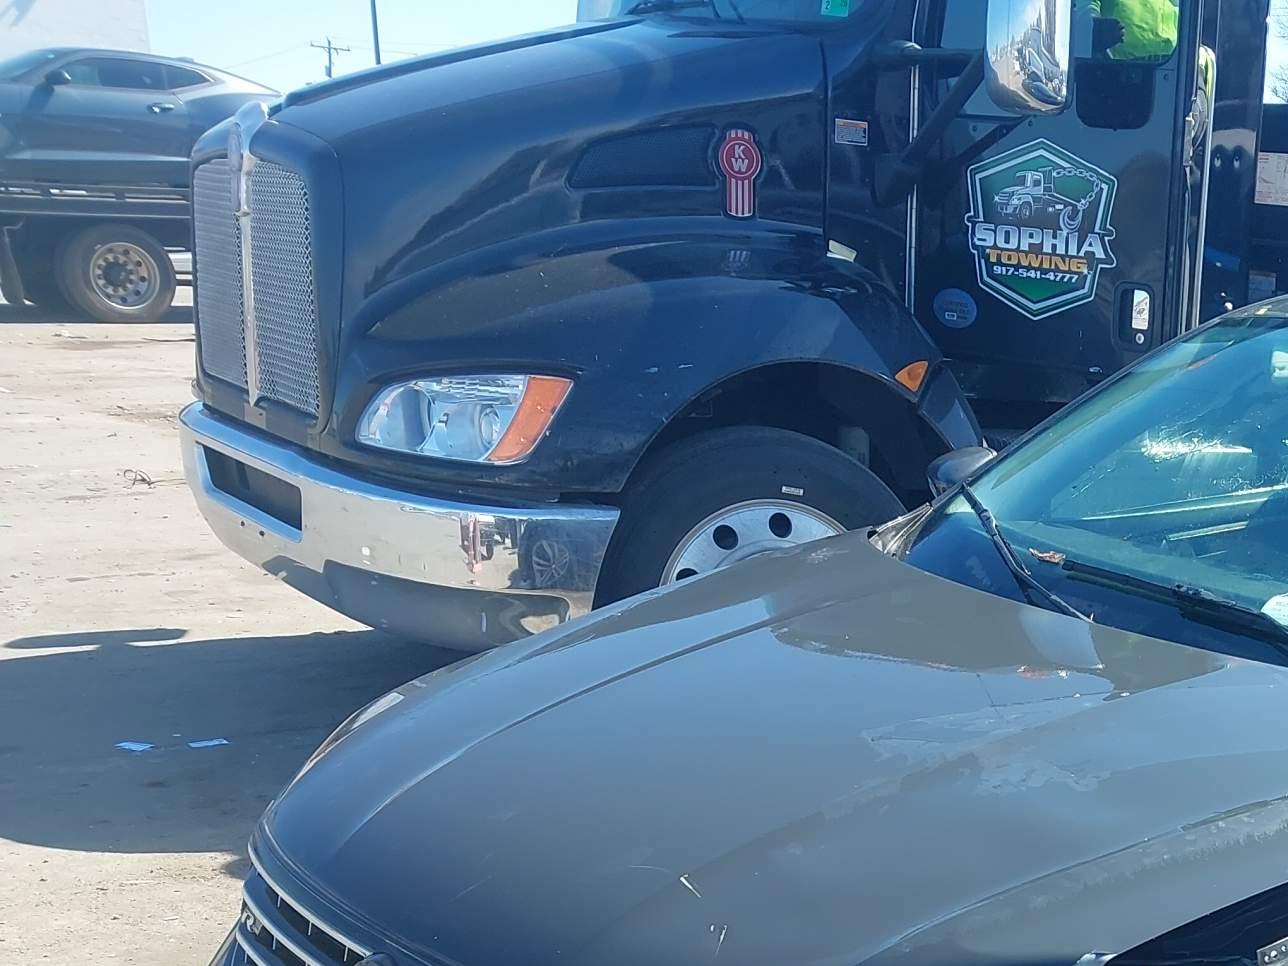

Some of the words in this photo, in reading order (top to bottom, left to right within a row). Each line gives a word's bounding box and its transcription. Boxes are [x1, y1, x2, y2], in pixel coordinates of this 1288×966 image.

[974, 222, 1107, 259] SOPHIA
[986, 249, 1089, 273] TOWING
[993, 265, 1080, 283] 917-541-4777
